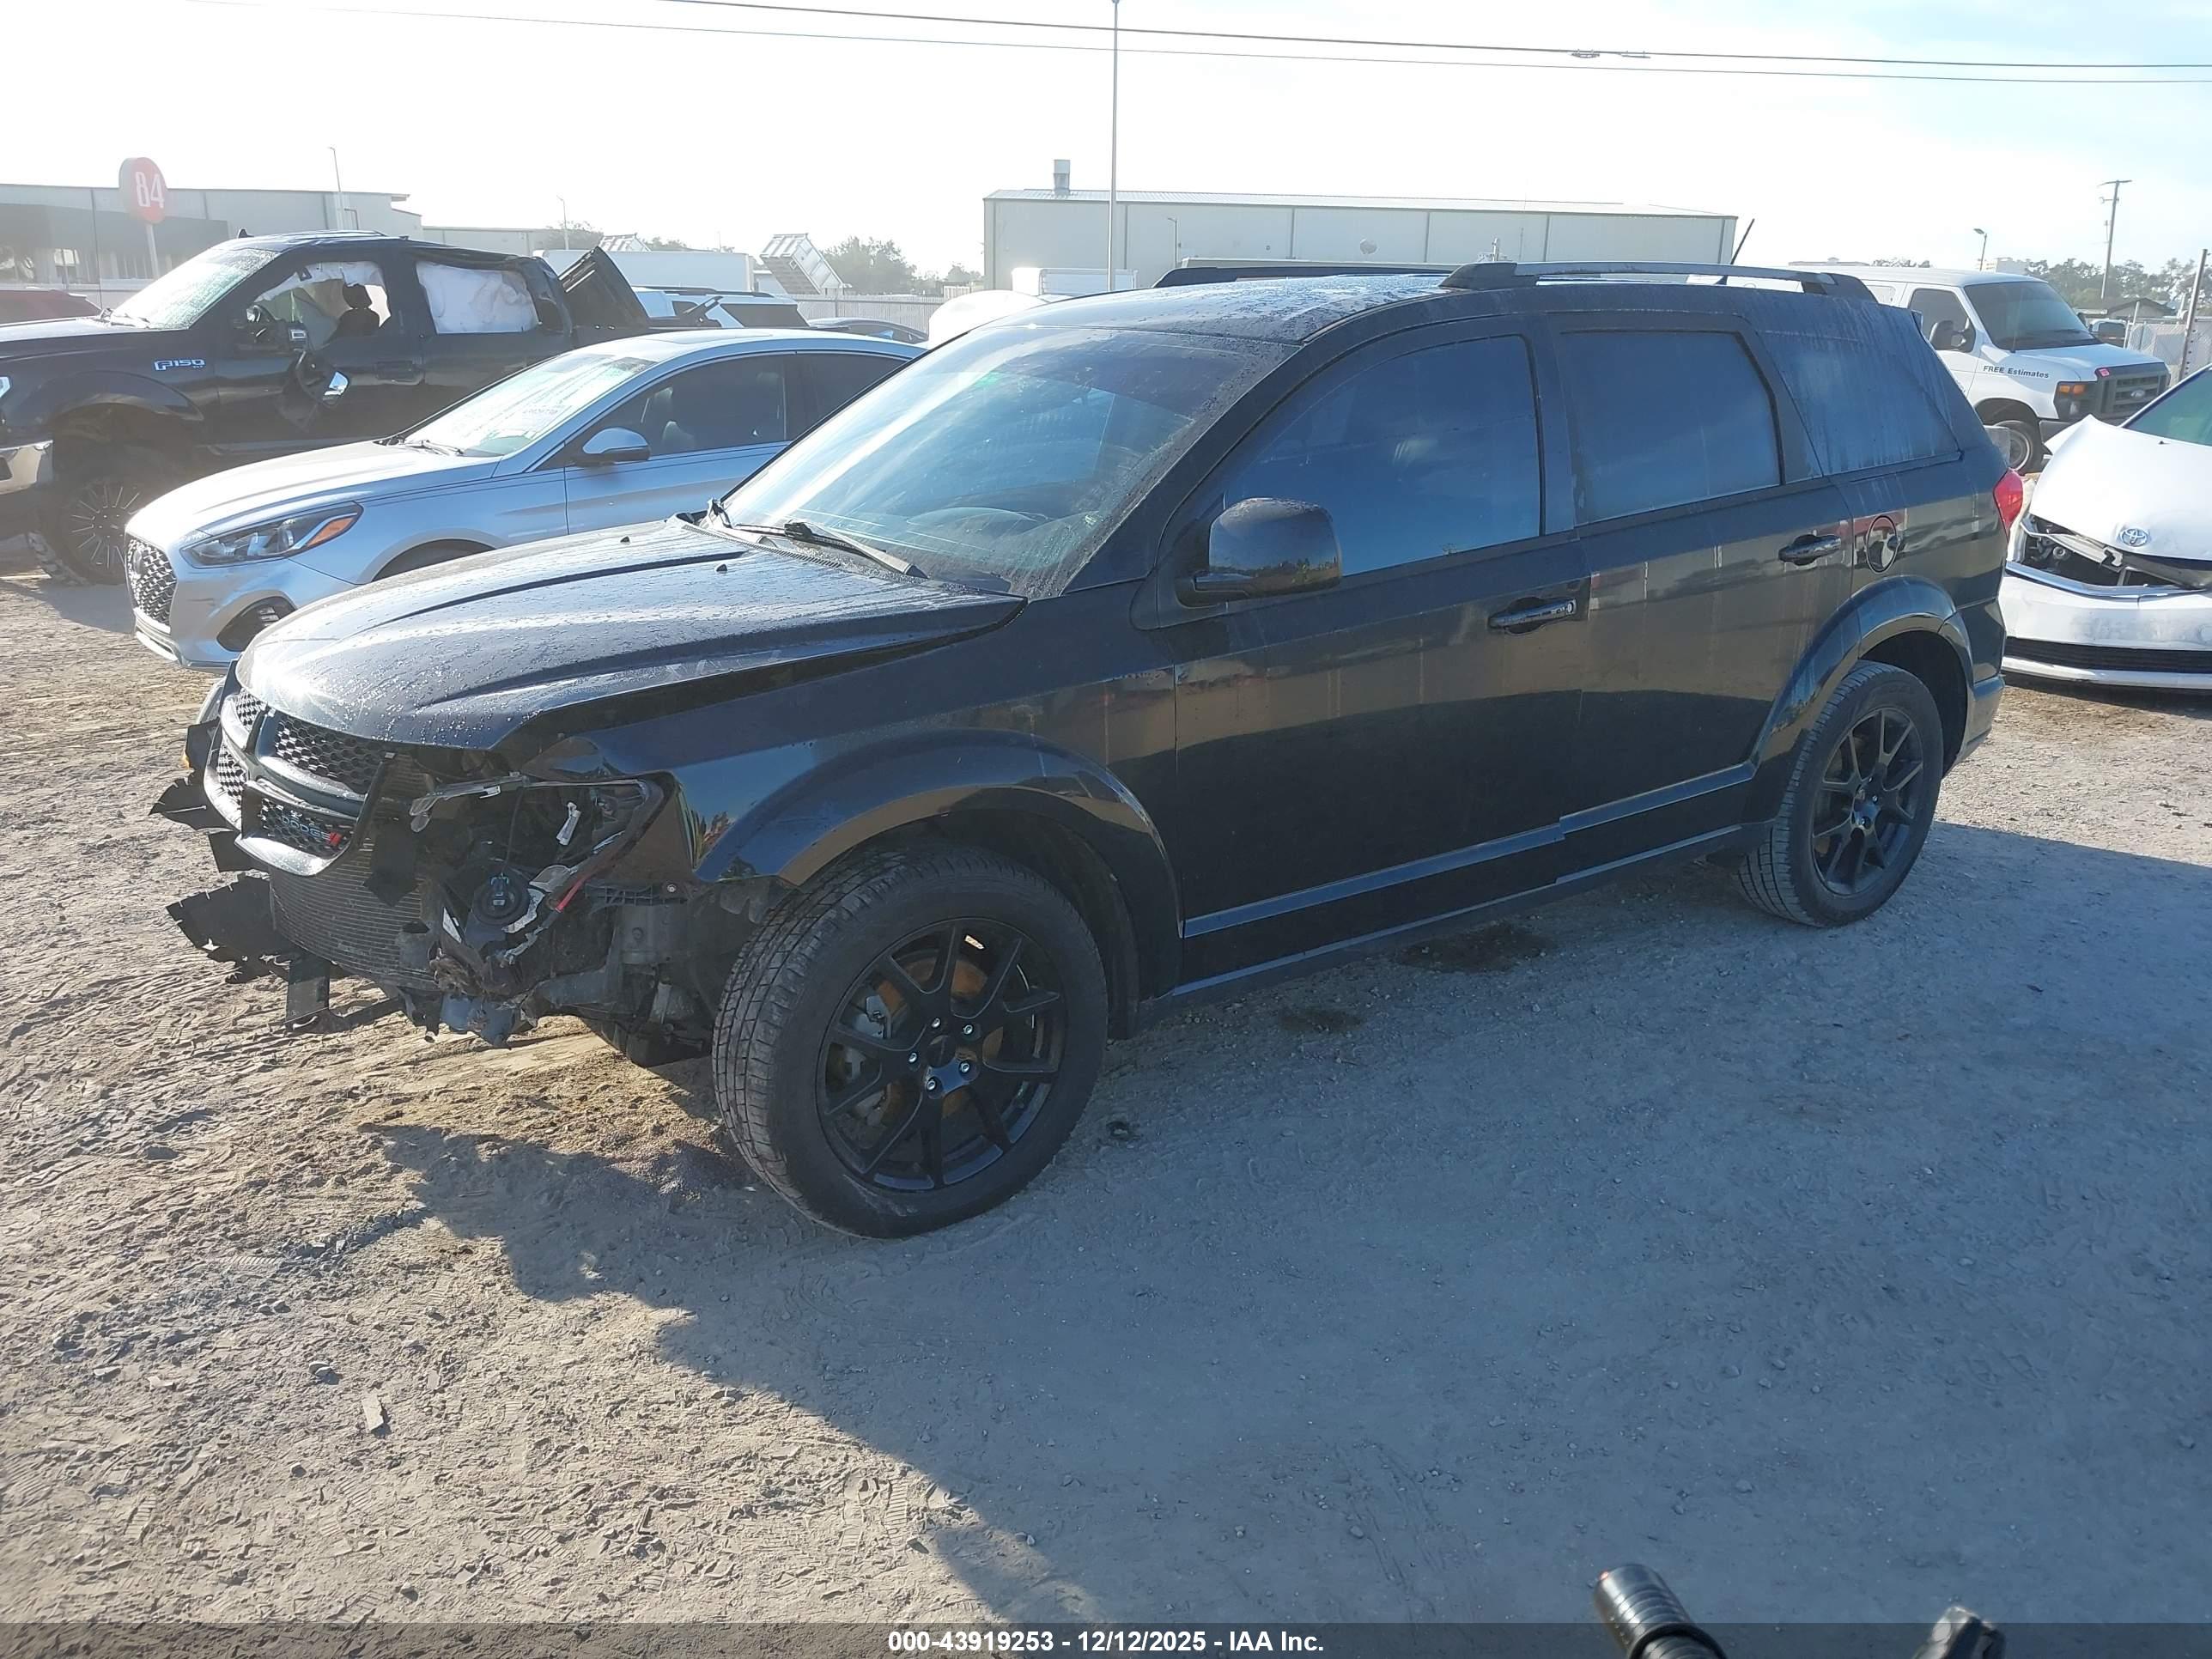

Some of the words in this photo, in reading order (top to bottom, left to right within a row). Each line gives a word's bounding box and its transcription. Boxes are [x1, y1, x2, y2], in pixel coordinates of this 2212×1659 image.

[135, 171, 165, 208] 84
[1983, 365, 2005, 374] FREE
[2007, 368, 2050, 379] Estimates
[281, 815, 331, 842] DODGE
